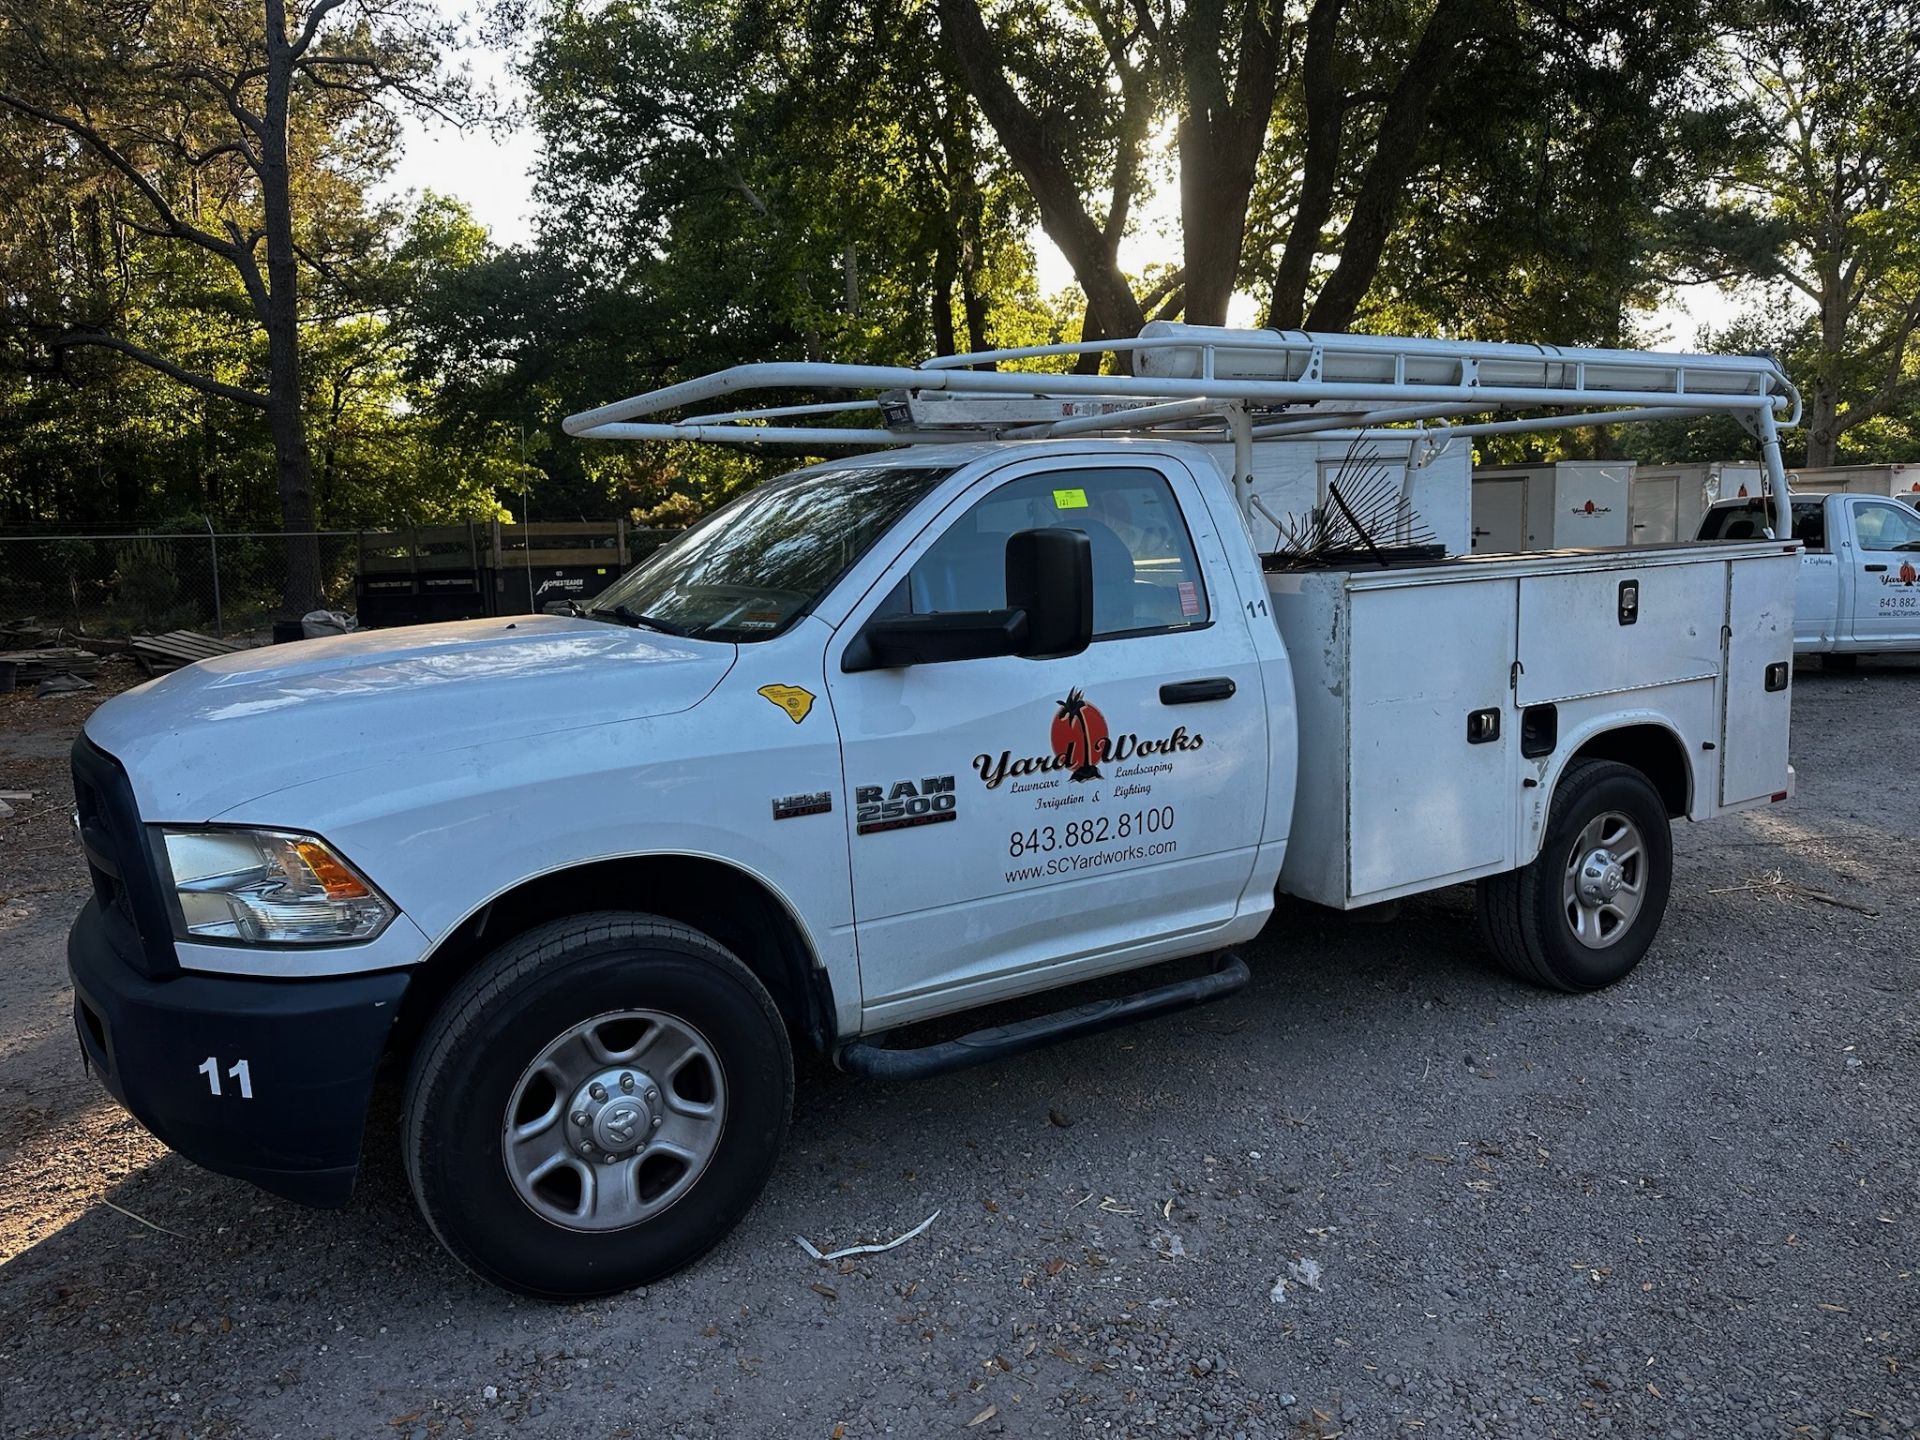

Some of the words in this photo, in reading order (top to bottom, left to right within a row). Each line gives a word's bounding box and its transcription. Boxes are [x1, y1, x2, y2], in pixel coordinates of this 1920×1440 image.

[1246, 599, 1268, 619] 11
[972, 740, 1076, 790] Yard
[1094, 725, 1204, 764] Works
[855, 774, 955, 804] RAM
[1009, 778, 1060, 794] Lawncare
[1114, 761, 1173, 779] Landscaping
[856, 792, 956, 824] 2500
[1034, 794, 1085, 811] Irrigation
[1091, 790, 1101, 803] &
[1113, 783, 1152, 799] Lighting
[1009, 805, 1175, 858] 843.882.8100
[1004, 839, 1177, 884] www.SCYardworks.com
[198, 1056, 253, 1099] 11
